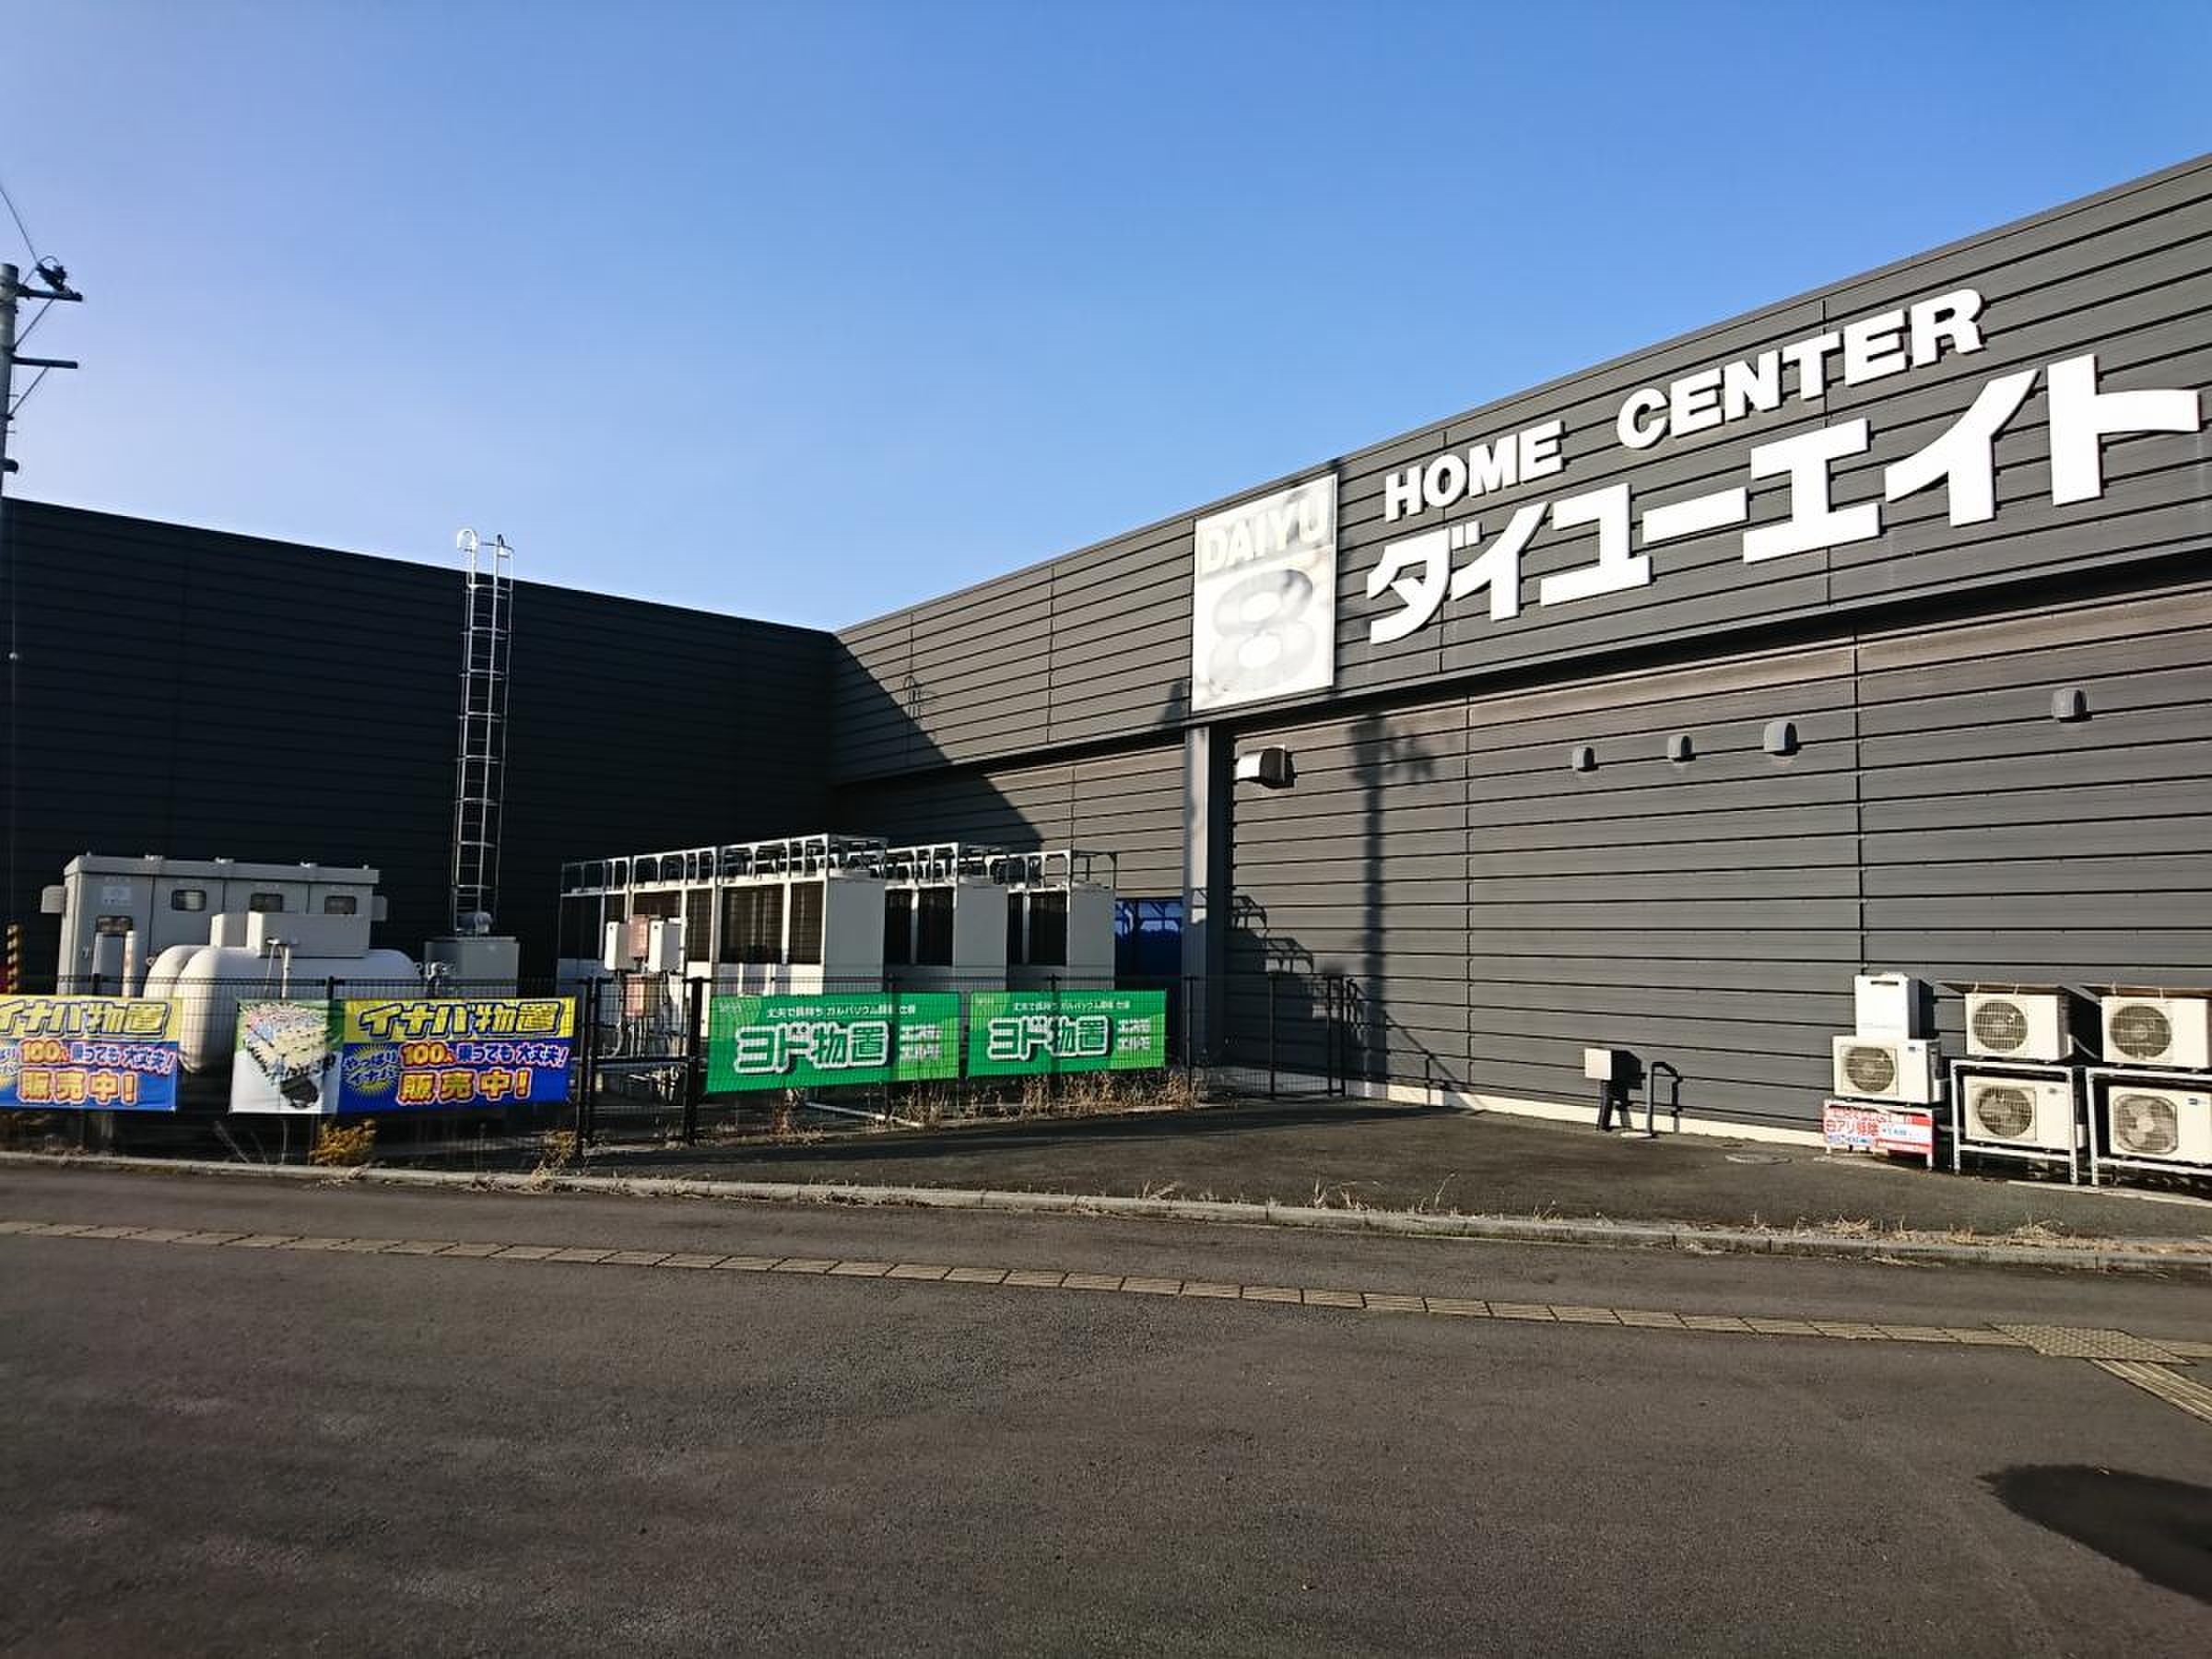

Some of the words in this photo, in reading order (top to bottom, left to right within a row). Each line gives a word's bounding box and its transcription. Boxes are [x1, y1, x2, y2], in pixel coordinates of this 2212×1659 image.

[1382, 419, 1566, 522] HOME
[1615, 288, 1986, 450] CENTER
[1197, 488, 1330, 577] DAIYU
[1366, 352, 2202, 645] ダイユーエイト
[1209, 568, 1316, 693] 8
[359, 1001, 563, 1040] イナバ物置
[733, 1020, 889, 1074] ヨド物置
[986, 1015, 1108, 1061] ヨド物置
